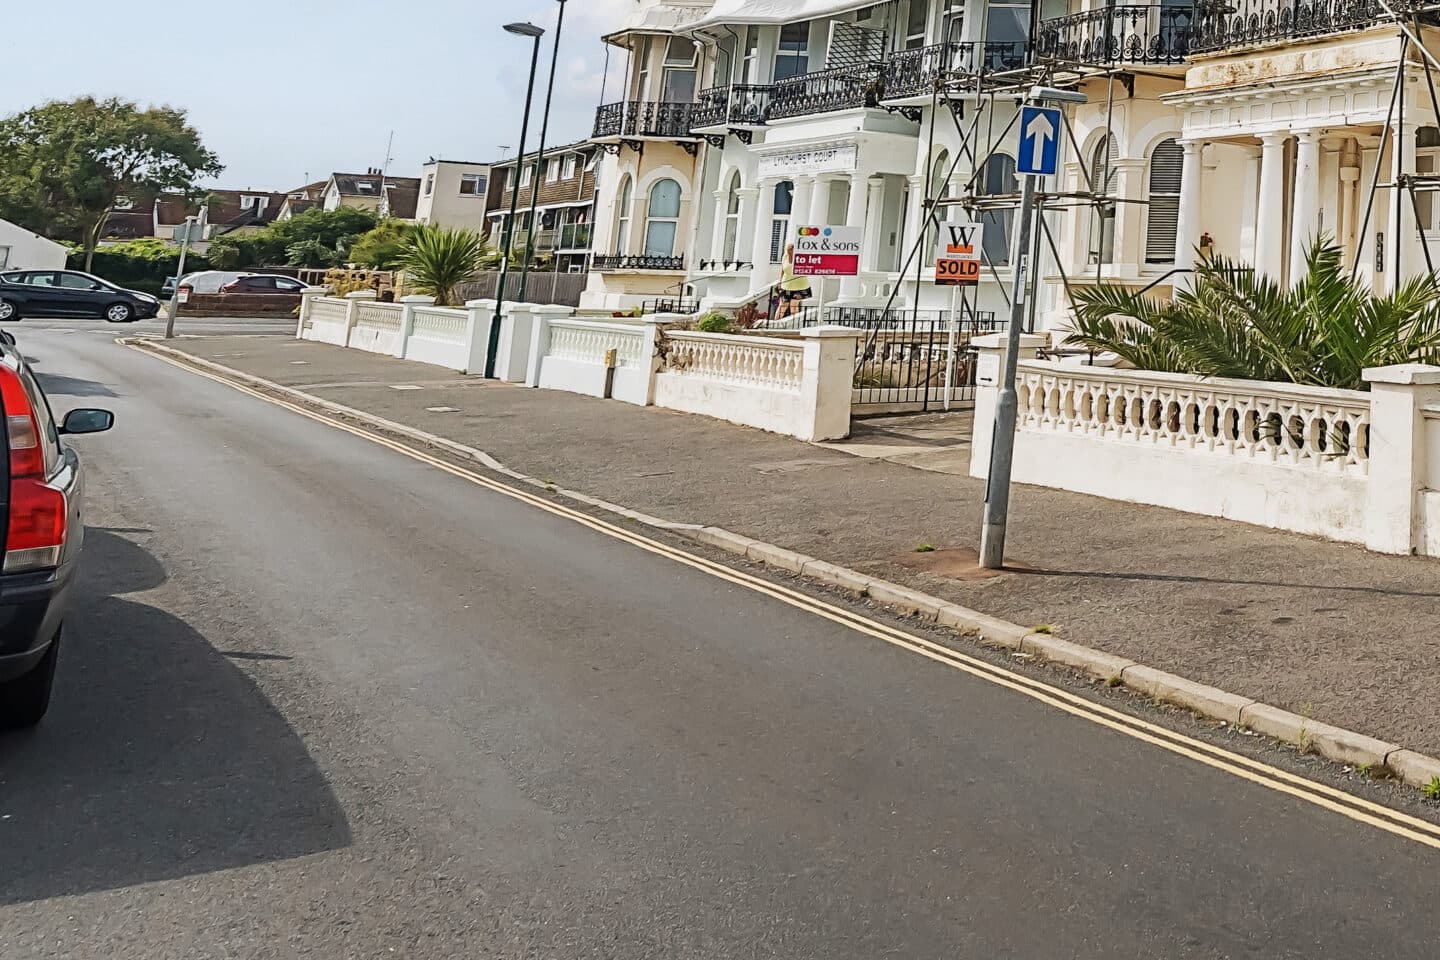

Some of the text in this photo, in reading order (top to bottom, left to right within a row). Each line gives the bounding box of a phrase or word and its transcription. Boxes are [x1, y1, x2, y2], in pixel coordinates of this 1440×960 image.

[813, 150, 837, 163] COURT
[948, 226, 976, 249] W
[797, 238, 859, 252] fox & sons
[795, 255, 821, 264] to let
[938, 261, 978, 275] SOLD
